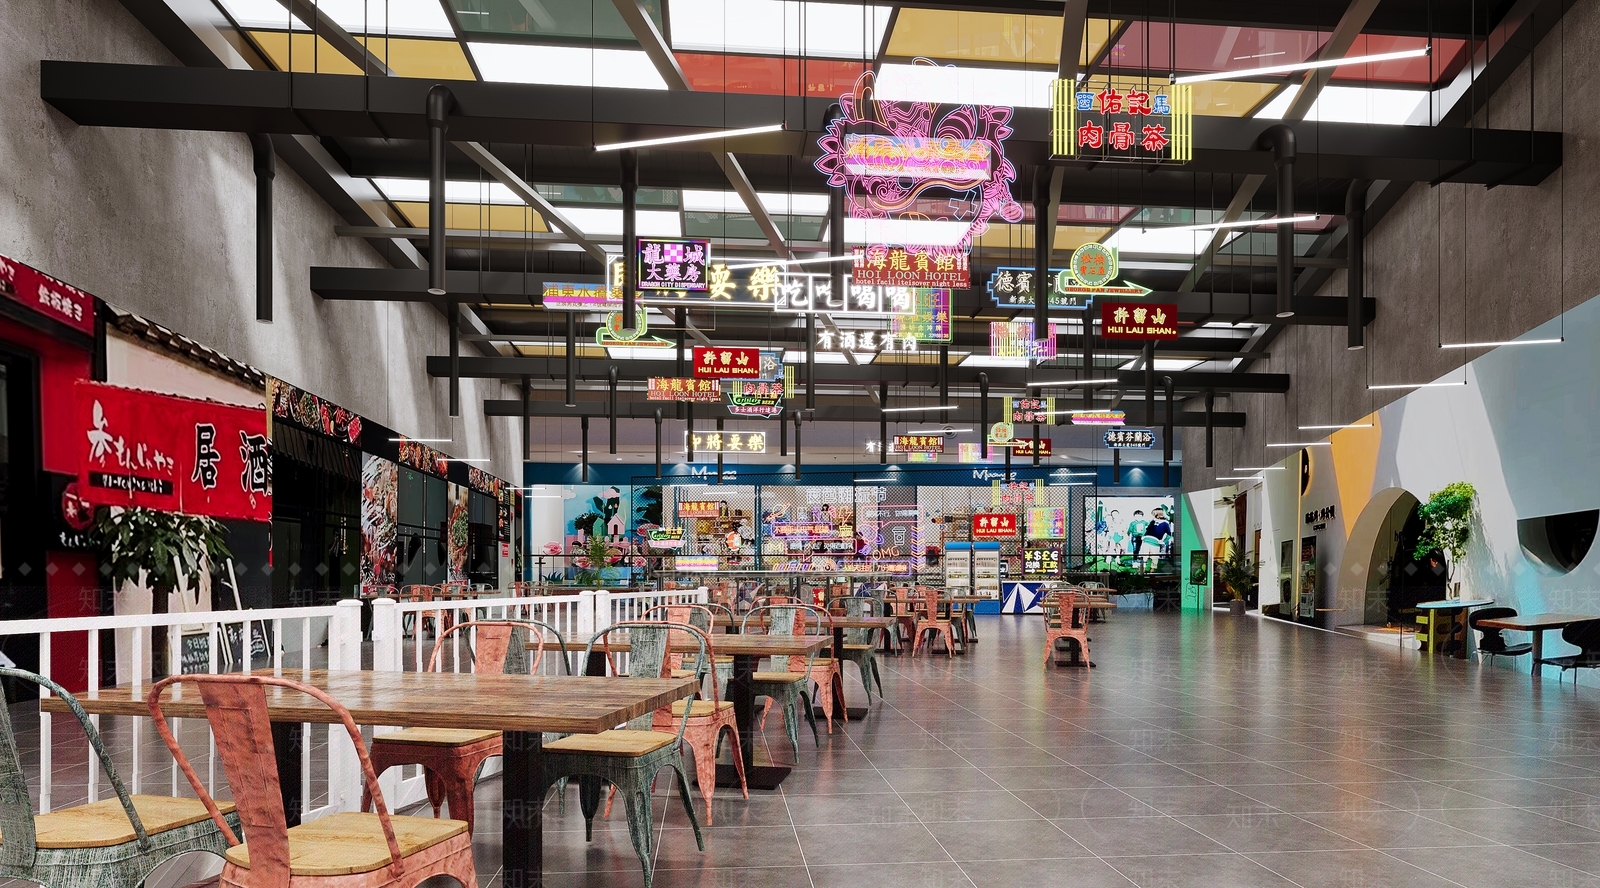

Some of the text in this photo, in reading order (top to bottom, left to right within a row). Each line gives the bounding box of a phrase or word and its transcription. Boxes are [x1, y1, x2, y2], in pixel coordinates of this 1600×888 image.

[1078, 120, 1170, 152] 肉骨茶
[646, 264, 701, 282] 大藥房
[857, 269, 965, 282] HOI LOON HOTEL
[1113, 306, 1167, 325] 許留山
[1107, 326, 1123, 334] HUI
[1125, 326, 1144, 334] LAU
[702, 350, 749, 366] 許留山
[697, 366, 712, 374] HUI
[713, 367, 730, 375] LAU
[656, 378, 711, 392] 海龍賓館
[873, 546, 900, 561] OMG
